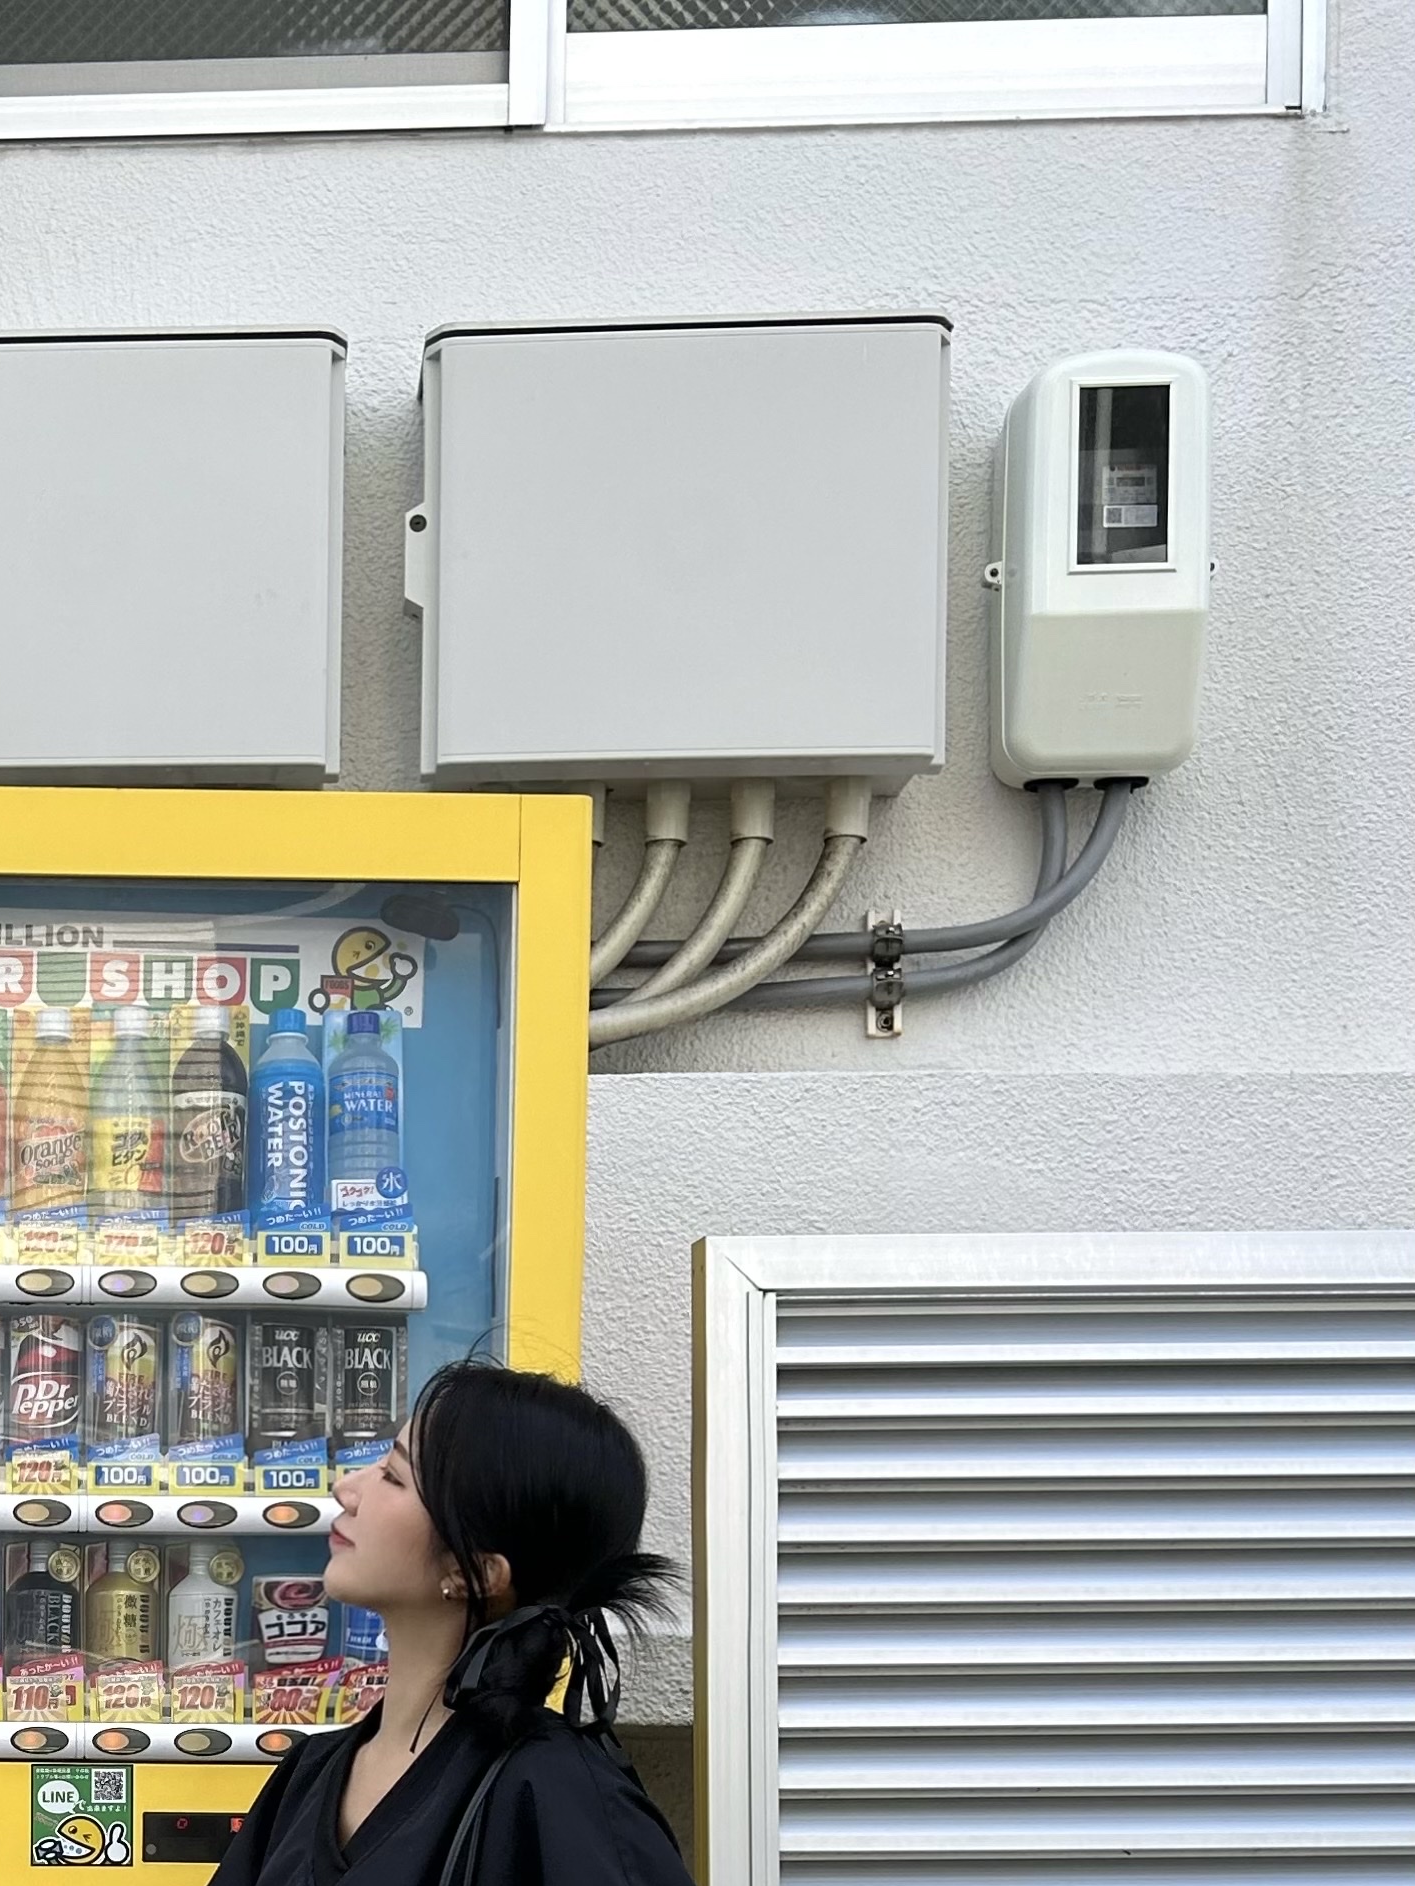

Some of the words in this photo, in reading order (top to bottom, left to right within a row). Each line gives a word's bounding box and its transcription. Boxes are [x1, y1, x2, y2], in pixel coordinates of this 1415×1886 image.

[101, 959, 292, 1002] SHOP
[343, 1090, 383, 1100] MINERAL
[344, 1100, 394, 1113] WATER
[267, 1082, 284, 1168] WATER
[20, 1133, 82, 1166] Orange
[201, 1123, 241, 1160] BEER
[288, 1081, 309, 1211] POSTONIC
[35, 1153, 67, 1171] soda
[299, 1221, 326, 1232] COLD
[381, 1222, 408, 1232] COLD
[270, 1235, 318, 1256] 100円
[354, 1235, 400, 1256] 100円
[261, 1346, 313, 1370] BLACK
[345, 1348, 392, 1371] BLACK
[118, 1372, 145, 1386] FIRE
[203, 1369, 228, 1382] FIRE
[37, 1379, 71, 1400] Dr
[11, 1384, 79, 1420] Pepper
[106, 1414, 148, 1427] BLEND
[191, 1410, 231, 1424] BLEND
[101, 1467, 148, 1486] 100円
[182, 1467, 230, 1486] 100円
[269, 1470, 315, 1488] 100円
[47, 1593, 61, 1643] BLACK
[123, 1594, 138, 1628] 微糖
[211, 1597, 222, 1653] カフェオレ
[265, 1618, 327, 1640] ココア
[12, 1684, 59, 1711] 110円
[177, 1684, 226, 1711] 120円
[269, 1688, 315, 1712] 80円
[42, 1790, 75, 1803] LINE
